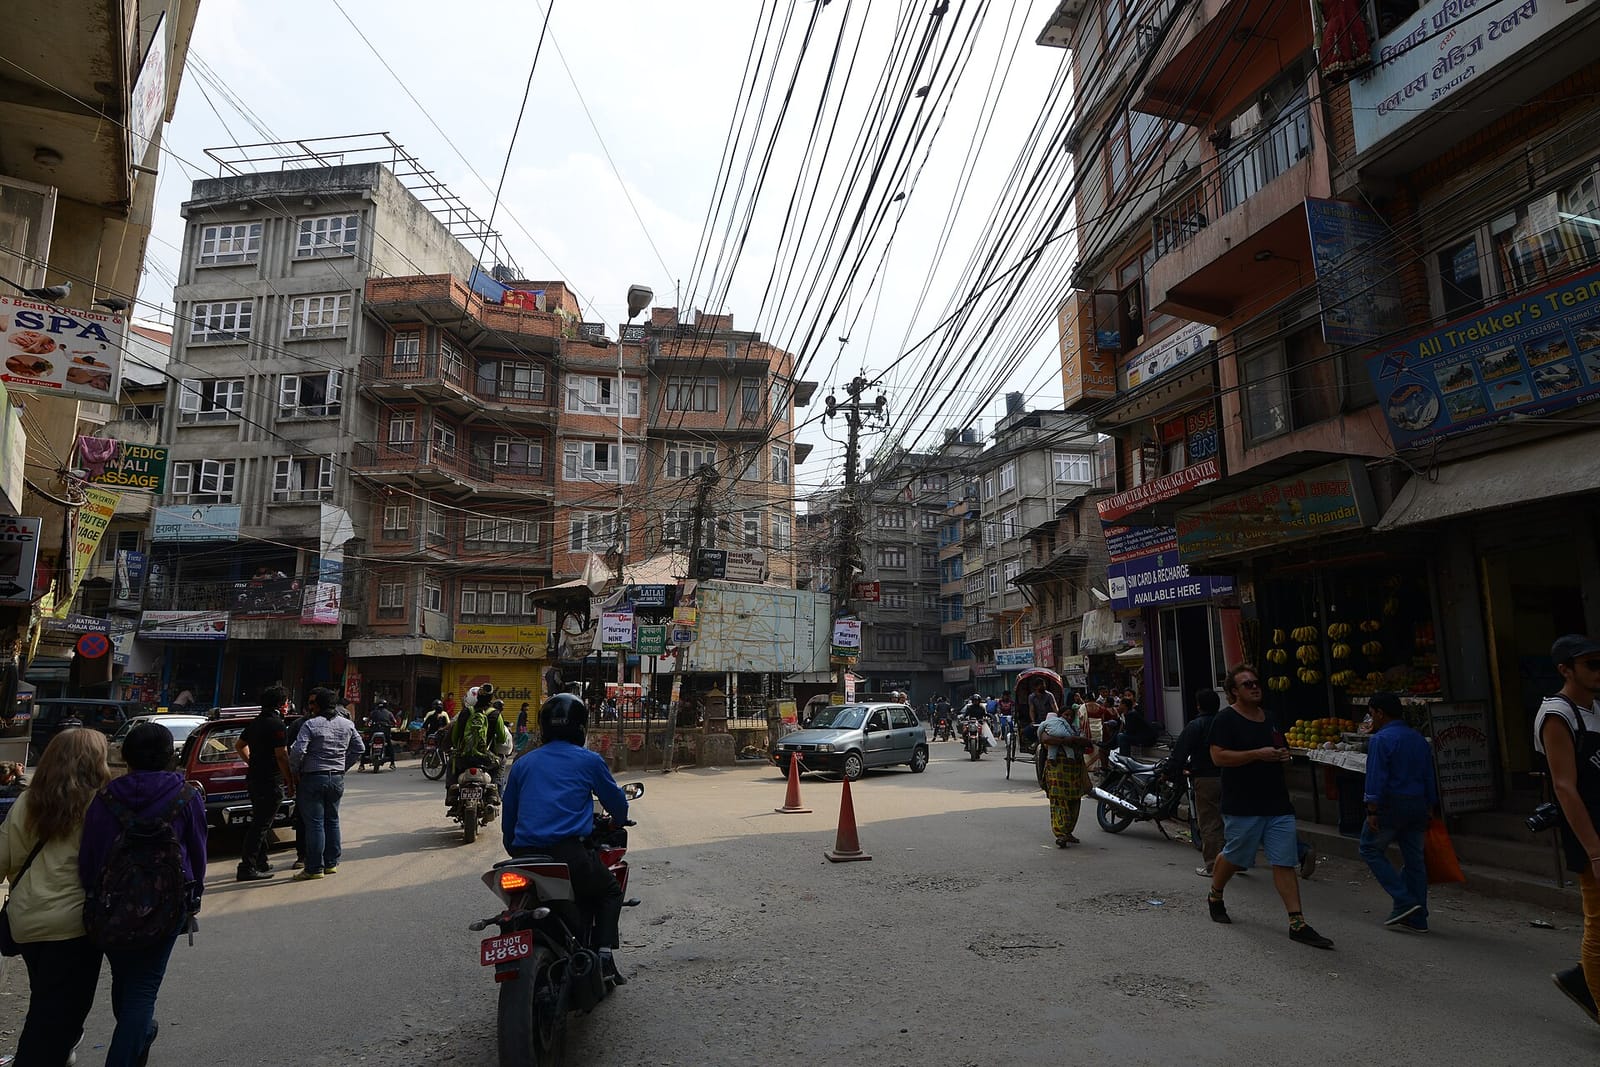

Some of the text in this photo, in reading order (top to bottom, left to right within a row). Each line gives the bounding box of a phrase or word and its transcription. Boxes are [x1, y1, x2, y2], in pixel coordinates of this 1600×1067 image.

[13, 299, 56, 314] Beauty
[63, 307, 109, 322] Parlour
[112, 317, 122, 325] &
[15, 311, 110, 343] SPA
[1418, 336, 1443, 358] All
[1448, 304, 1542, 348] Trekker's
[1083, 375, 1114, 385] PALACE
[125, 445, 165, 461] VEDIC
[104, 459, 148, 472] IMALI
[90, 471, 159, 488] ASSAGE
[1110, 487, 1142, 508] COMPUTER
[1142, 486, 1148, 496] &
[1147, 472, 1184, 496] LANGUAGE
[1184, 460, 1216, 482] CENTER
[80, 512, 107, 529] PUTER
[1309, 507, 1357, 525] Bhandar
[1128, 575, 1137, 588] SIM
[1136, 571, 1152, 587] CARD
[1157, 565, 1190, 582] RECHARGE
[1134, 583, 1201, 605] AVAILABLE HERE
[840, 631, 858, 639] Nursery
[461, 644, 499, 654] PRAVINA
[492, 687, 532, 700] Kodak
